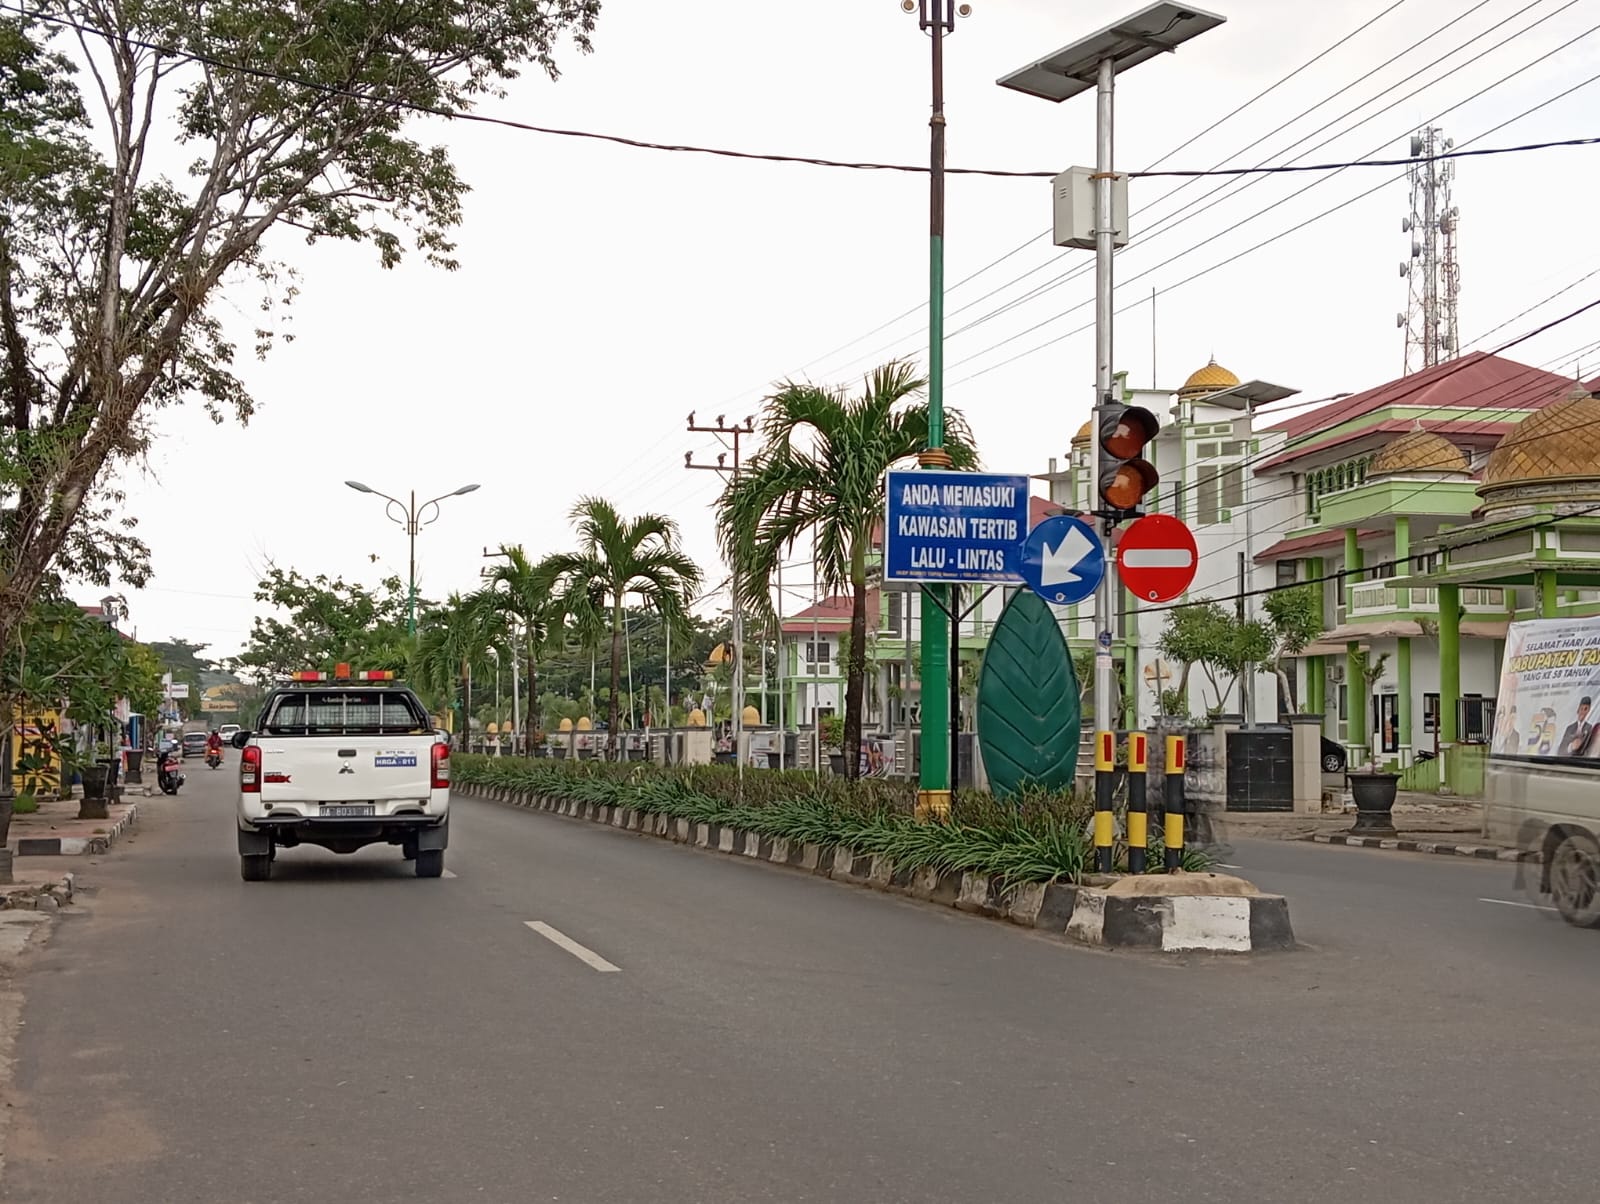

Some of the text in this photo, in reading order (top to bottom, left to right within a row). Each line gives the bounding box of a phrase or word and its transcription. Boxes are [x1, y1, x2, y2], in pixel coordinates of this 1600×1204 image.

[902, 484, 1015, 508] ANDA MEMASUKI
[898, 515, 1018, 541] KAWASAN TERTIB
[911, 547, 945, 569] LALU
[957, 548, 1004, 571] LINTAS
[1526, 640, 1561, 651] SELAMAT
[1562, 638, 1585, 648] HARI
[1510, 649, 1579, 673] KABUPATEN
[1523, 671, 1541, 681] YANG
[1563, 667, 1592, 678] TAHUN
